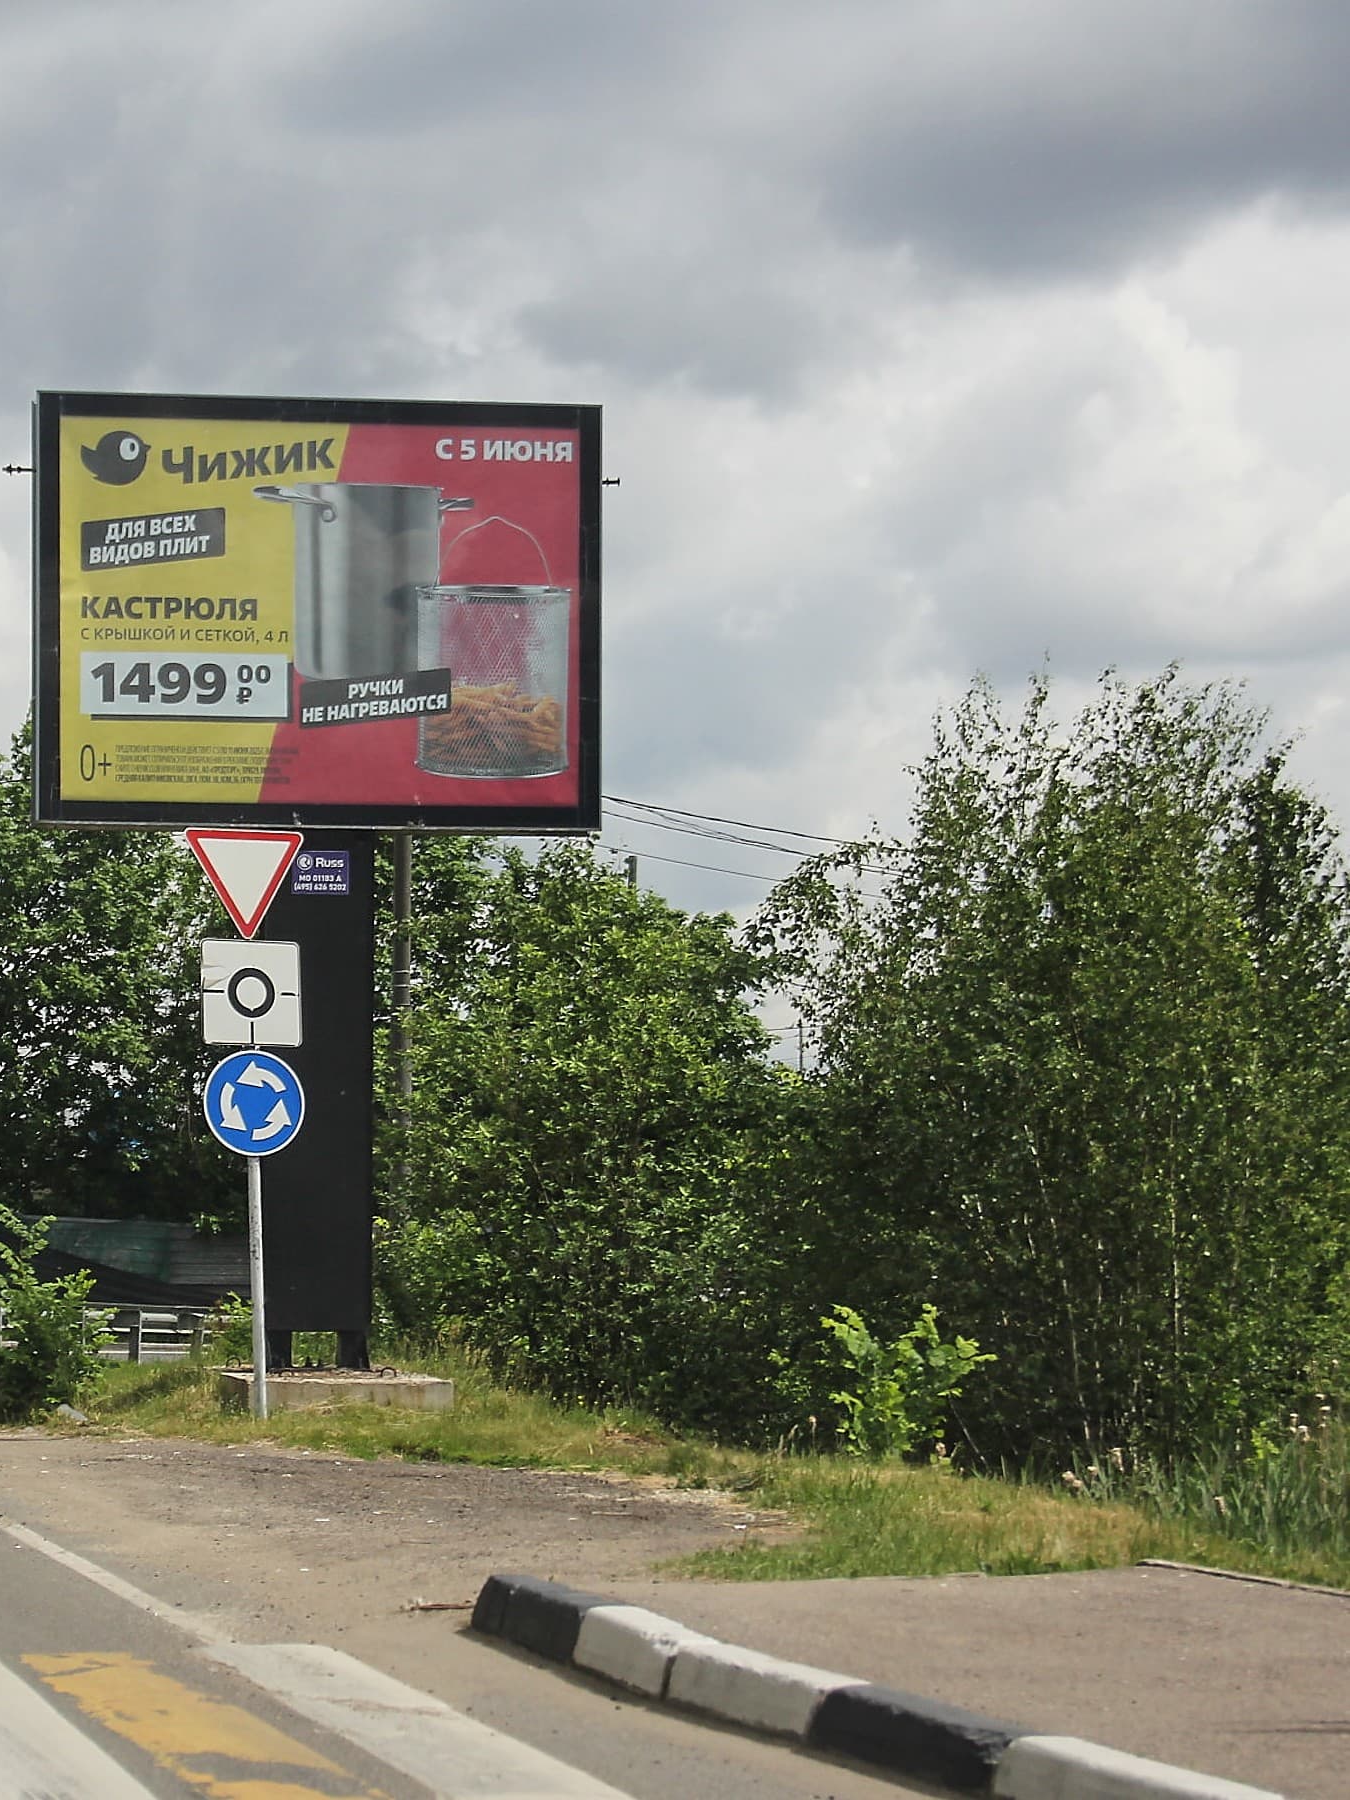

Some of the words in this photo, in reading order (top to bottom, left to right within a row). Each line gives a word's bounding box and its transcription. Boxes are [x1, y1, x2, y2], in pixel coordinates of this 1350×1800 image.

[435, 438, 453, 460] С
[460, 439, 476, 461] 5
[482, 440, 573, 462] ИЮНЯ
[105, 520, 146, 544] ДЛЯ
[149, 514, 197, 536] ВСЕХ
[88, 541, 156, 565] ВИДОВ
[159, 535, 211, 557] ПЛИТ
[81, 596, 258, 621] КАСТРЮЛЯ
[80, 628, 89, 640] С
[94, 626, 176, 641] КРЫШКОЙ
[180, 628, 190, 641] И
[195, 627, 260, 644] СЕТКОЙ,
[264, 630, 274, 642] 4
[278, 630, 288, 643] Л
[91, 662, 227, 704] 1499
[237, 664, 271, 684] 00
[348, 679, 404, 699] РУЧКИ
[302, 706, 324, 723] НЕ
[327, 693, 448, 721] НАГРЕВАЮТСЯ
[80, 744, 112, 782] 0+
[315, 857, 345, 868] Russ
[293, 882, 312, 891] (495)
